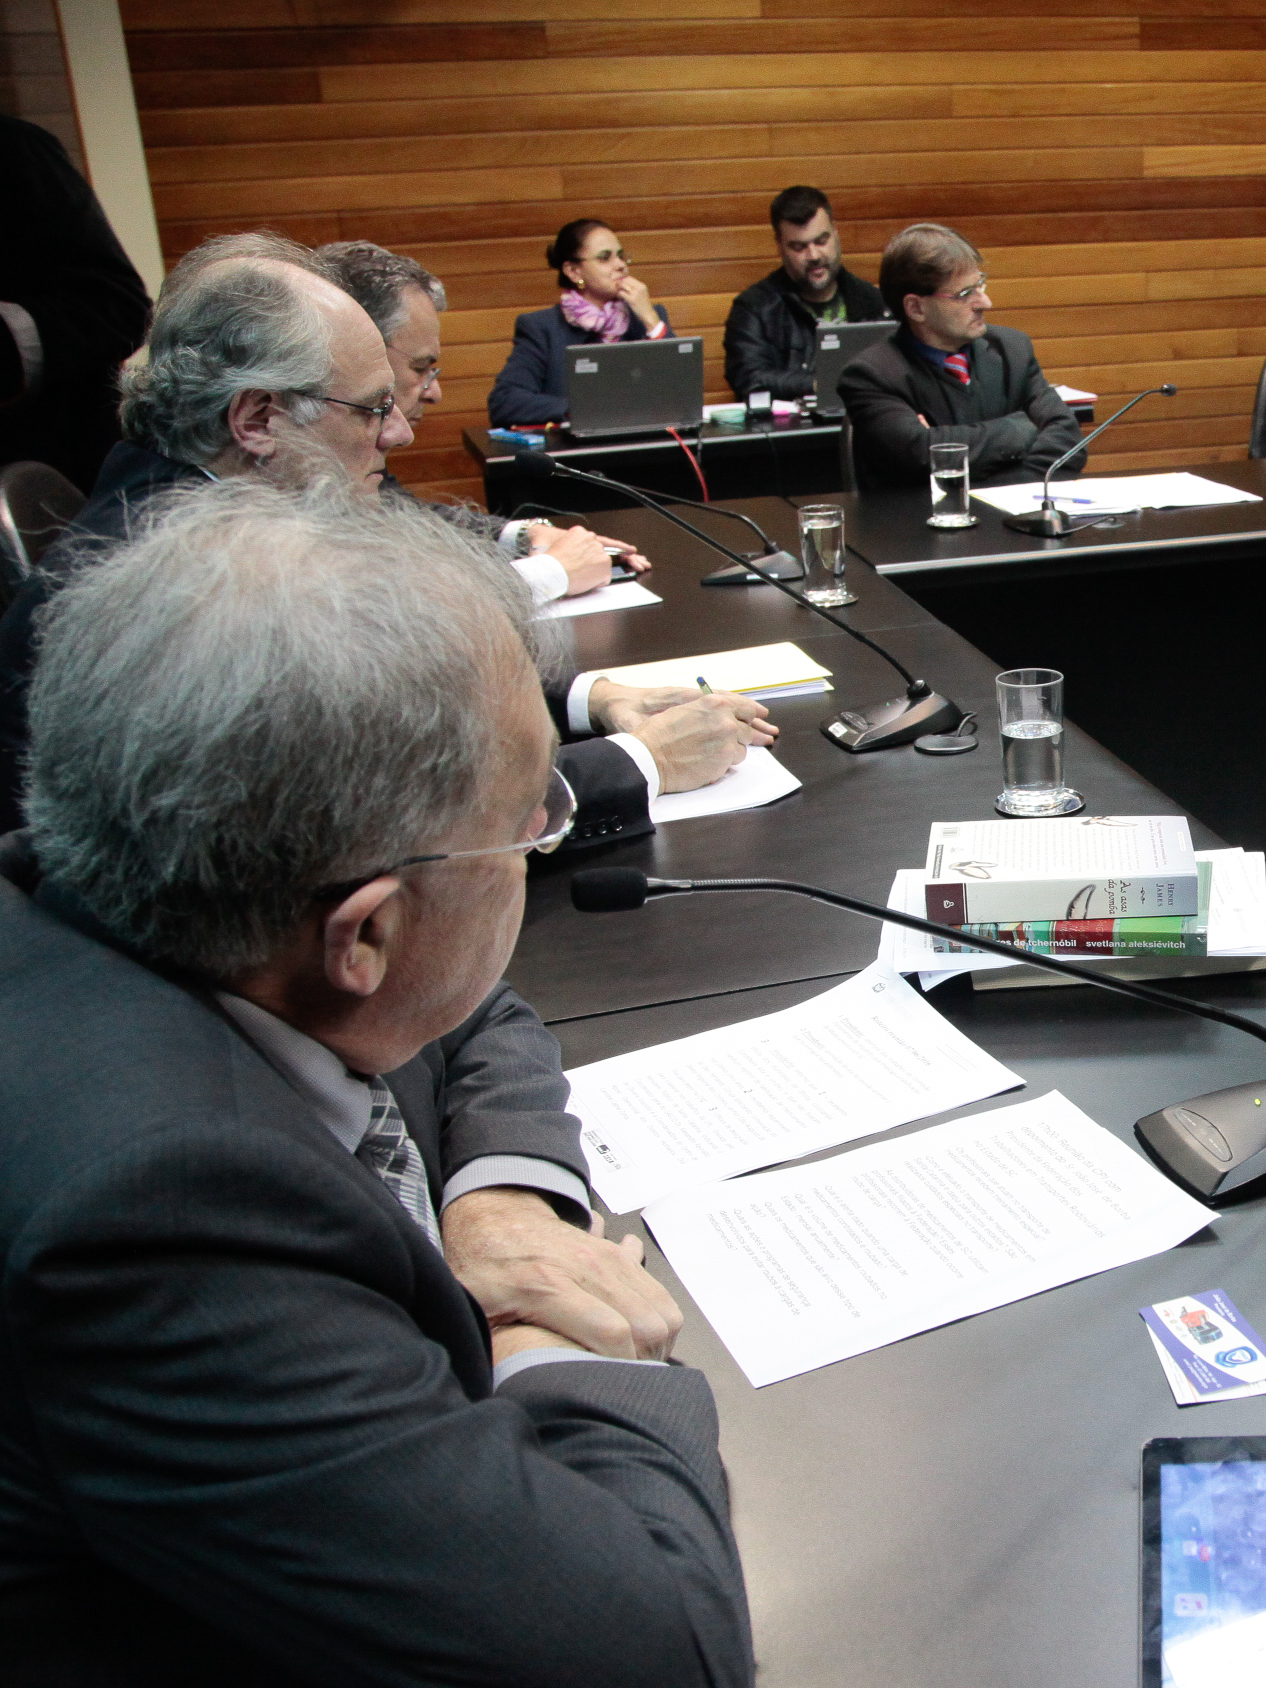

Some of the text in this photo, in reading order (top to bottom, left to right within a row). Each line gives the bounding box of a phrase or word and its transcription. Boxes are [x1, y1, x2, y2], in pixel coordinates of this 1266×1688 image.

[1028, 939, 1077, 947] tchernóbil
[1085, 940, 1126, 948] svetlana
[1128, 940, 1186, 949] aleksiévitch
